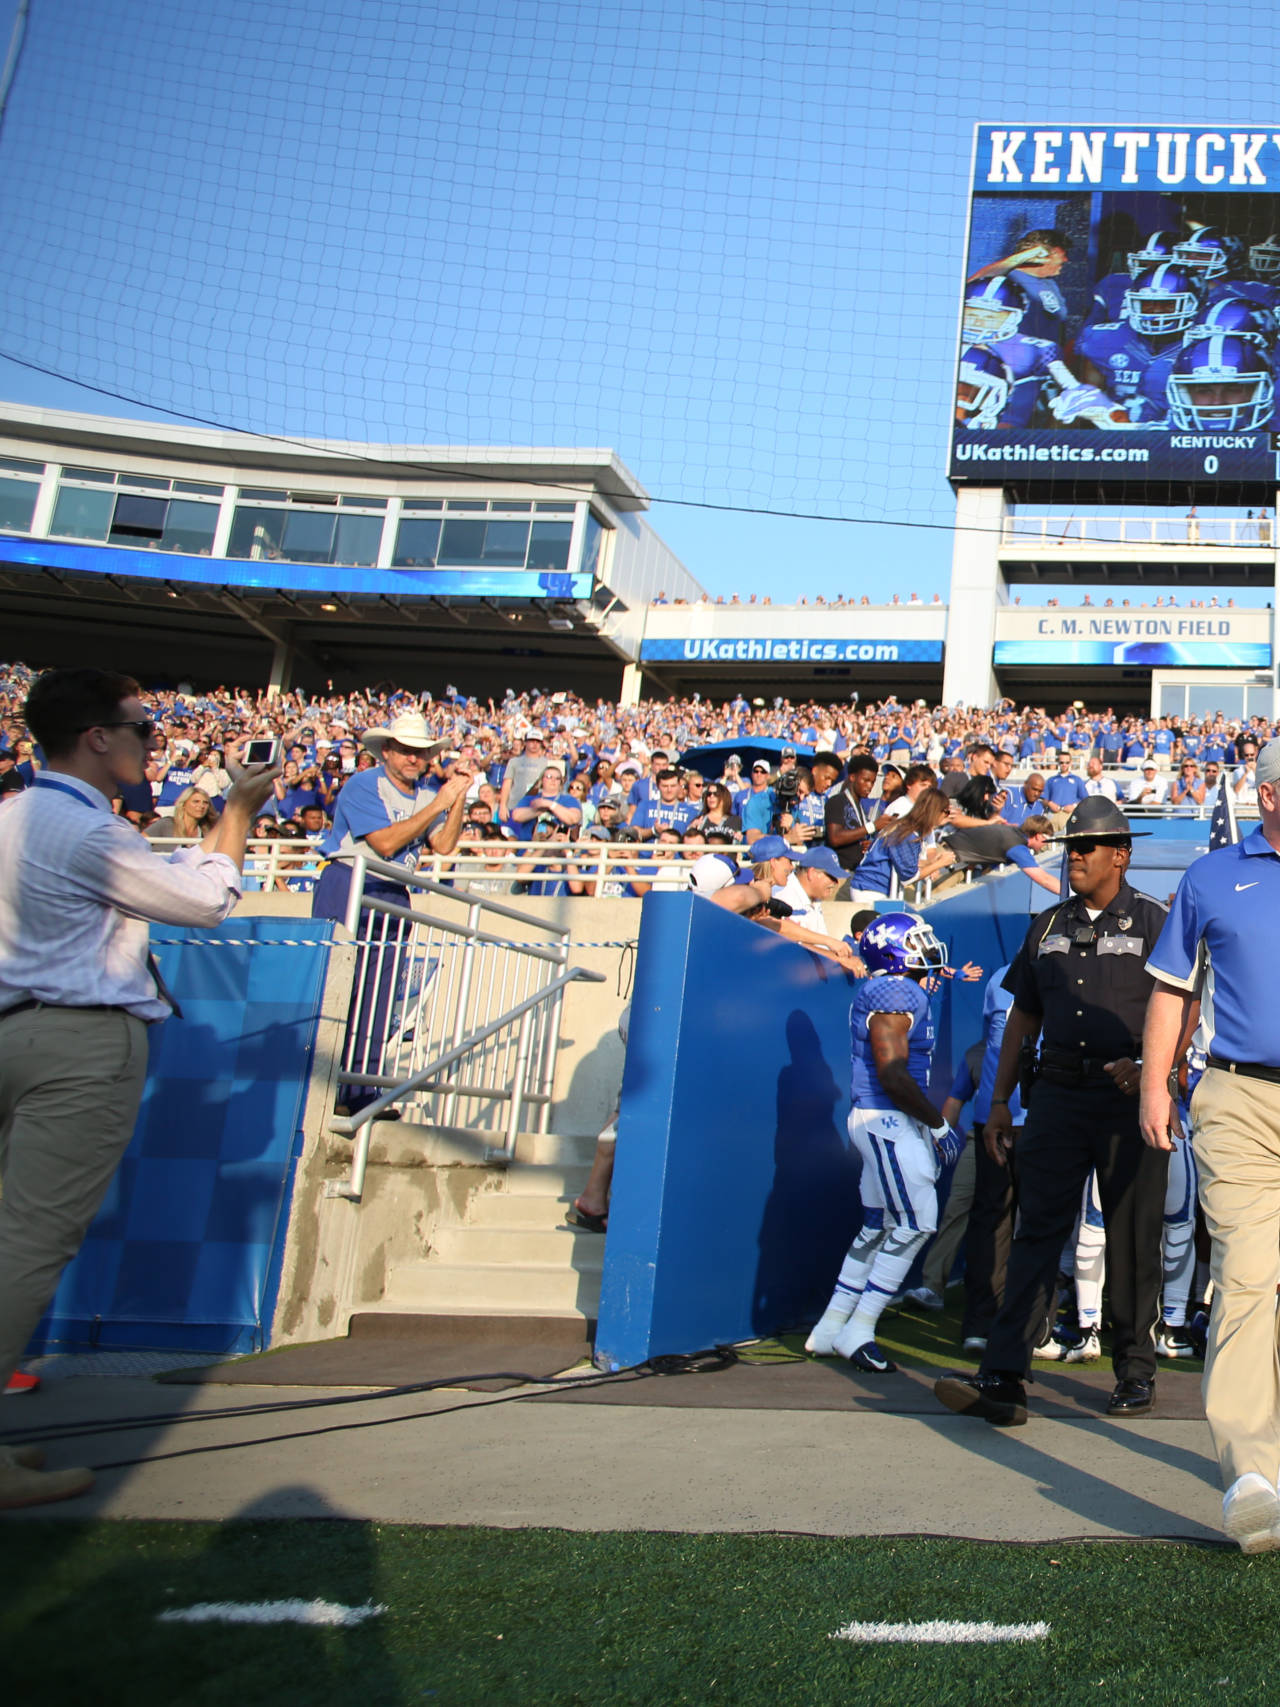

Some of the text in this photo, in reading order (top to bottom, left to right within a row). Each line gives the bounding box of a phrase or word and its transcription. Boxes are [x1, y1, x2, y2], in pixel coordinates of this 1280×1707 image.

[1170, 435, 1257, 449] KENTUCKY
[956, 444, 1149, 462] UKathletics.com
[1204, 455, 1219, 474] 0
[1038, 619, 1231, 636] C. M. NEWTON FIELD
[684, 639, 899, 661] UKathletics.com
